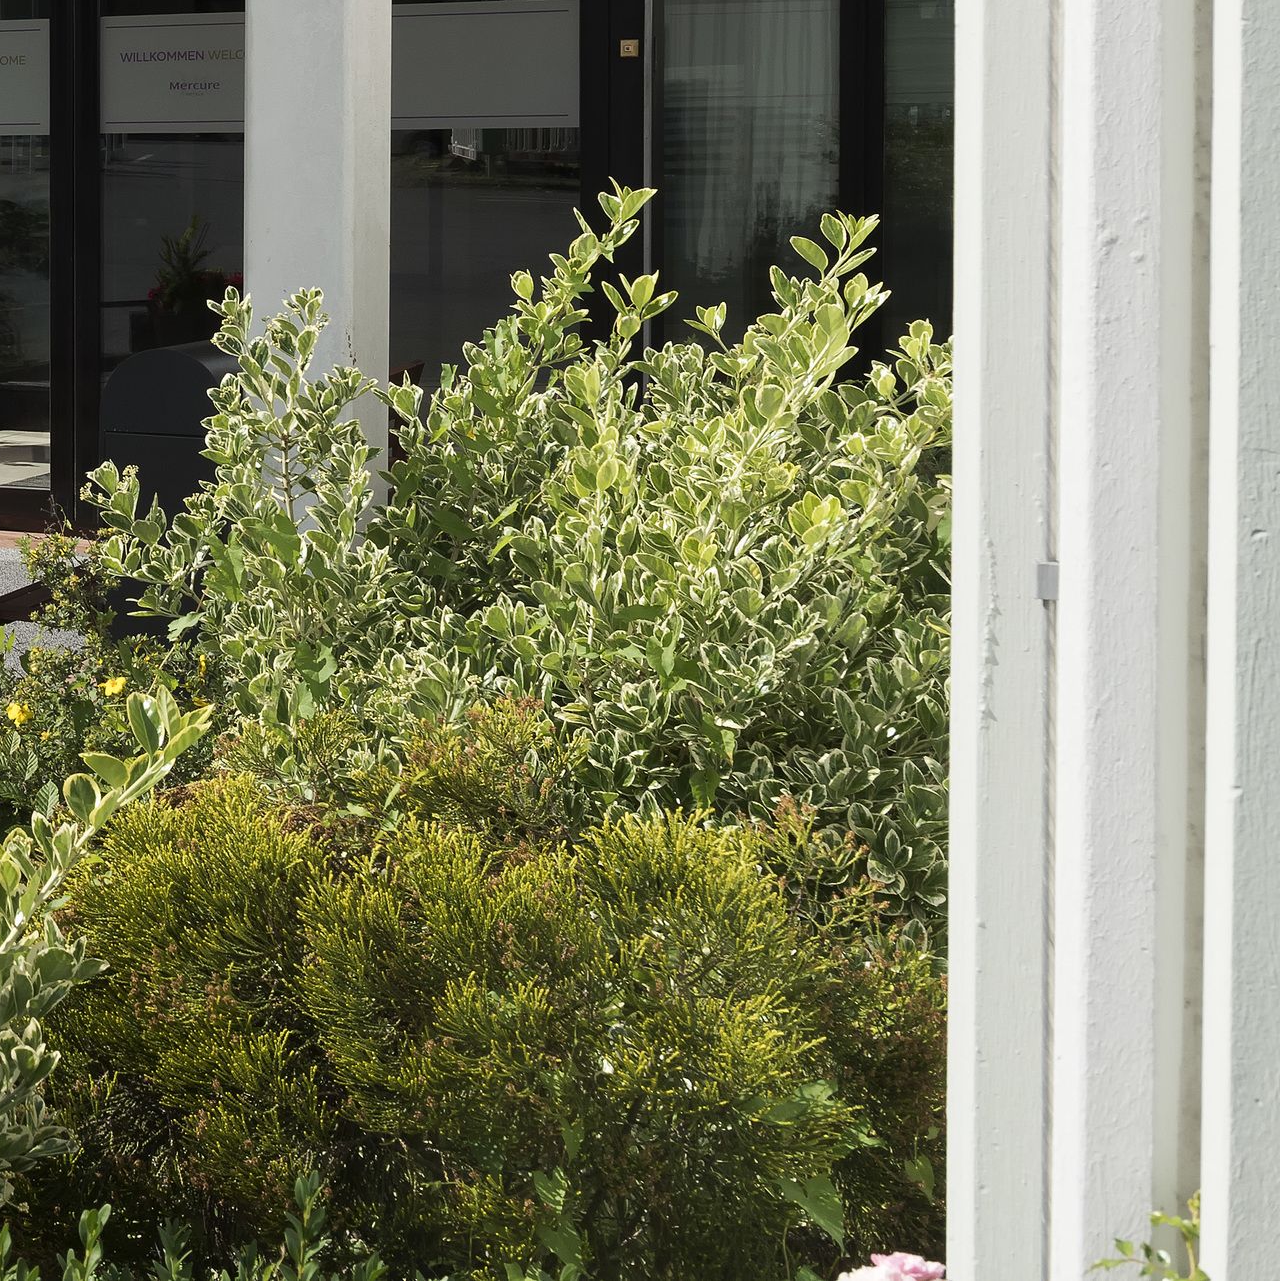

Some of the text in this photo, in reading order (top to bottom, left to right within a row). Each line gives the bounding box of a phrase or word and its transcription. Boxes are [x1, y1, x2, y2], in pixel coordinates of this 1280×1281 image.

[120, 49, 245, 62] WILLKOMMEN WELC
[169, 81, 220, 90] Mercure
